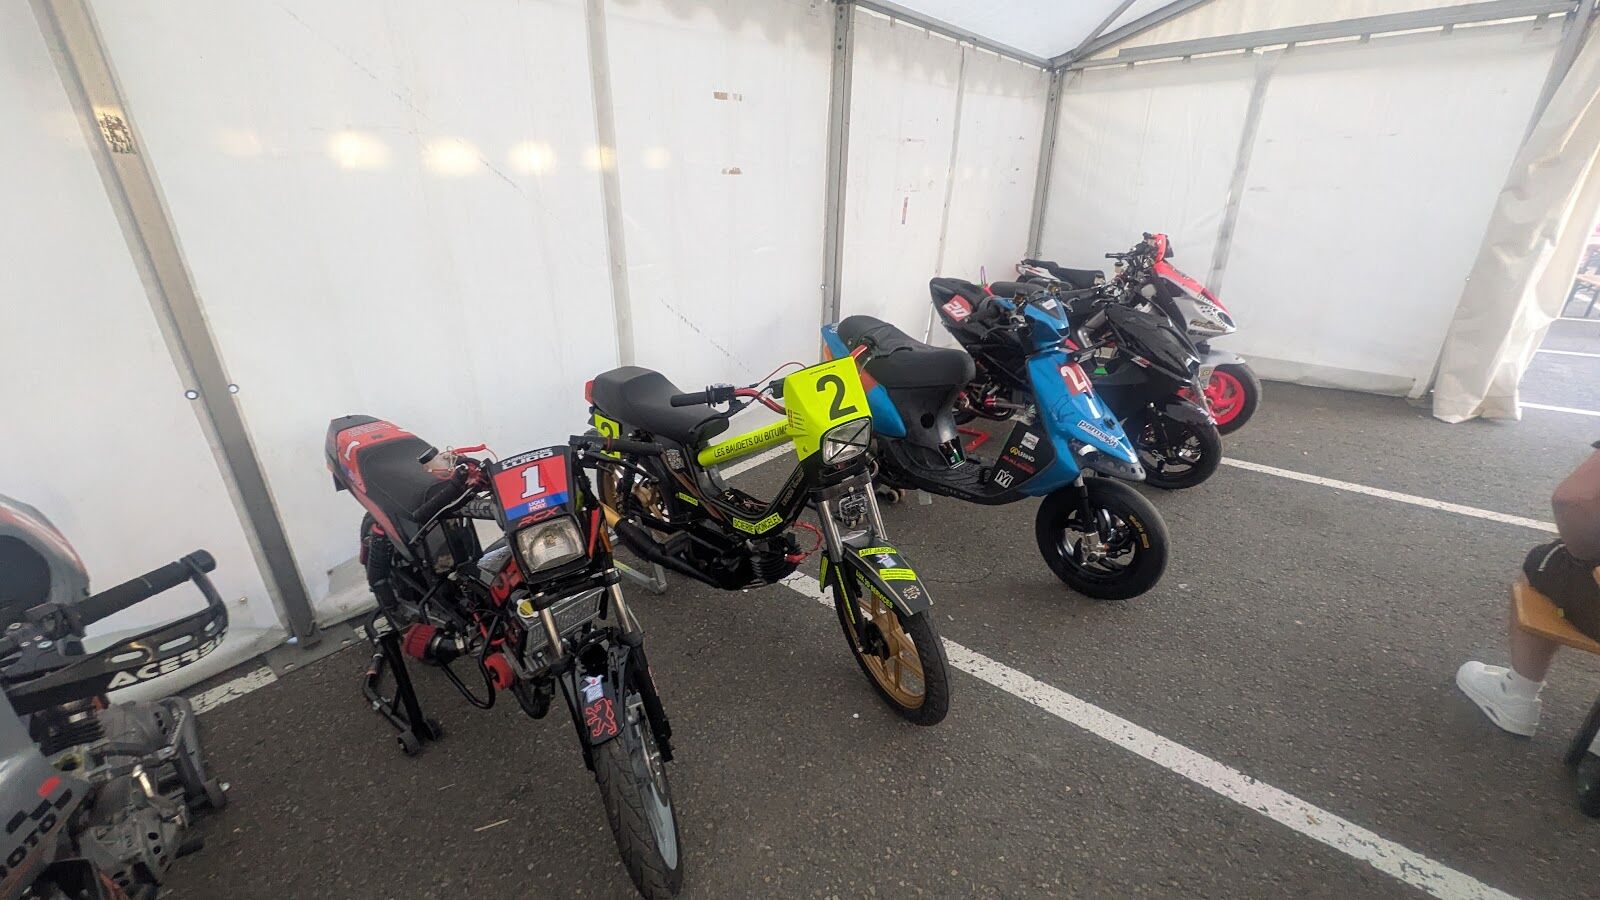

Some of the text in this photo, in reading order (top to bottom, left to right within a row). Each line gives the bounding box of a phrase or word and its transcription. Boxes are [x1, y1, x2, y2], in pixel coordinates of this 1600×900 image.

[942, 300, 971, 318] 20
[816, 374, 858, 420] 2
[713, 446, 726, 458] LES
[725, 438, 753, 453] BAUDETS
[754, 434, 763, 444] DU
[521, 464, 546, 499] 1
